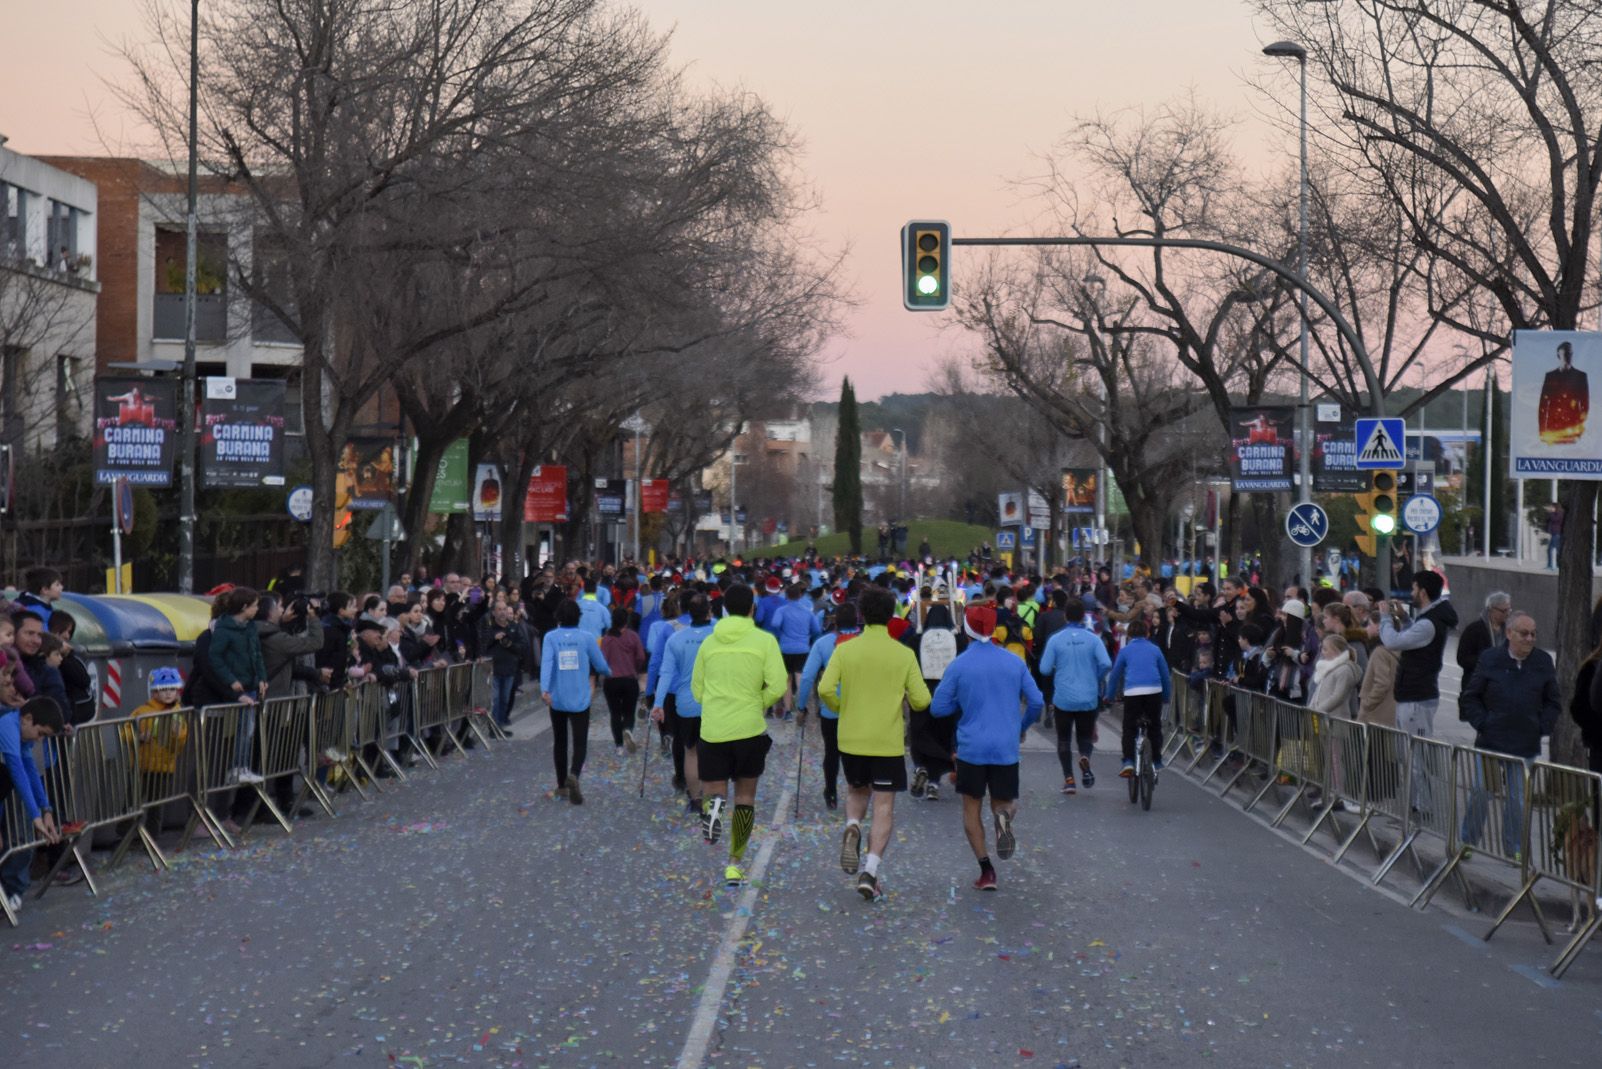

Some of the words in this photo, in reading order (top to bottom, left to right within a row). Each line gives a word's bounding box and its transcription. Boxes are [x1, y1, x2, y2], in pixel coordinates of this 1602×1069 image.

[104, 427, 164, 443] CARMINA
[212, 424, 273, 441] CARMINA
[108, 443, 161, 459] BURANA
[216, 440, 270, 456] BURANA
[1238, 446, 1285, 458] CARMINA
[1322, 441, 1356, 454] CARMI
[1241, 458, 1284, 471] BURANA
[1325, 454, 1357, 466] BURA
[1517, 459, 1530, 470] LA
